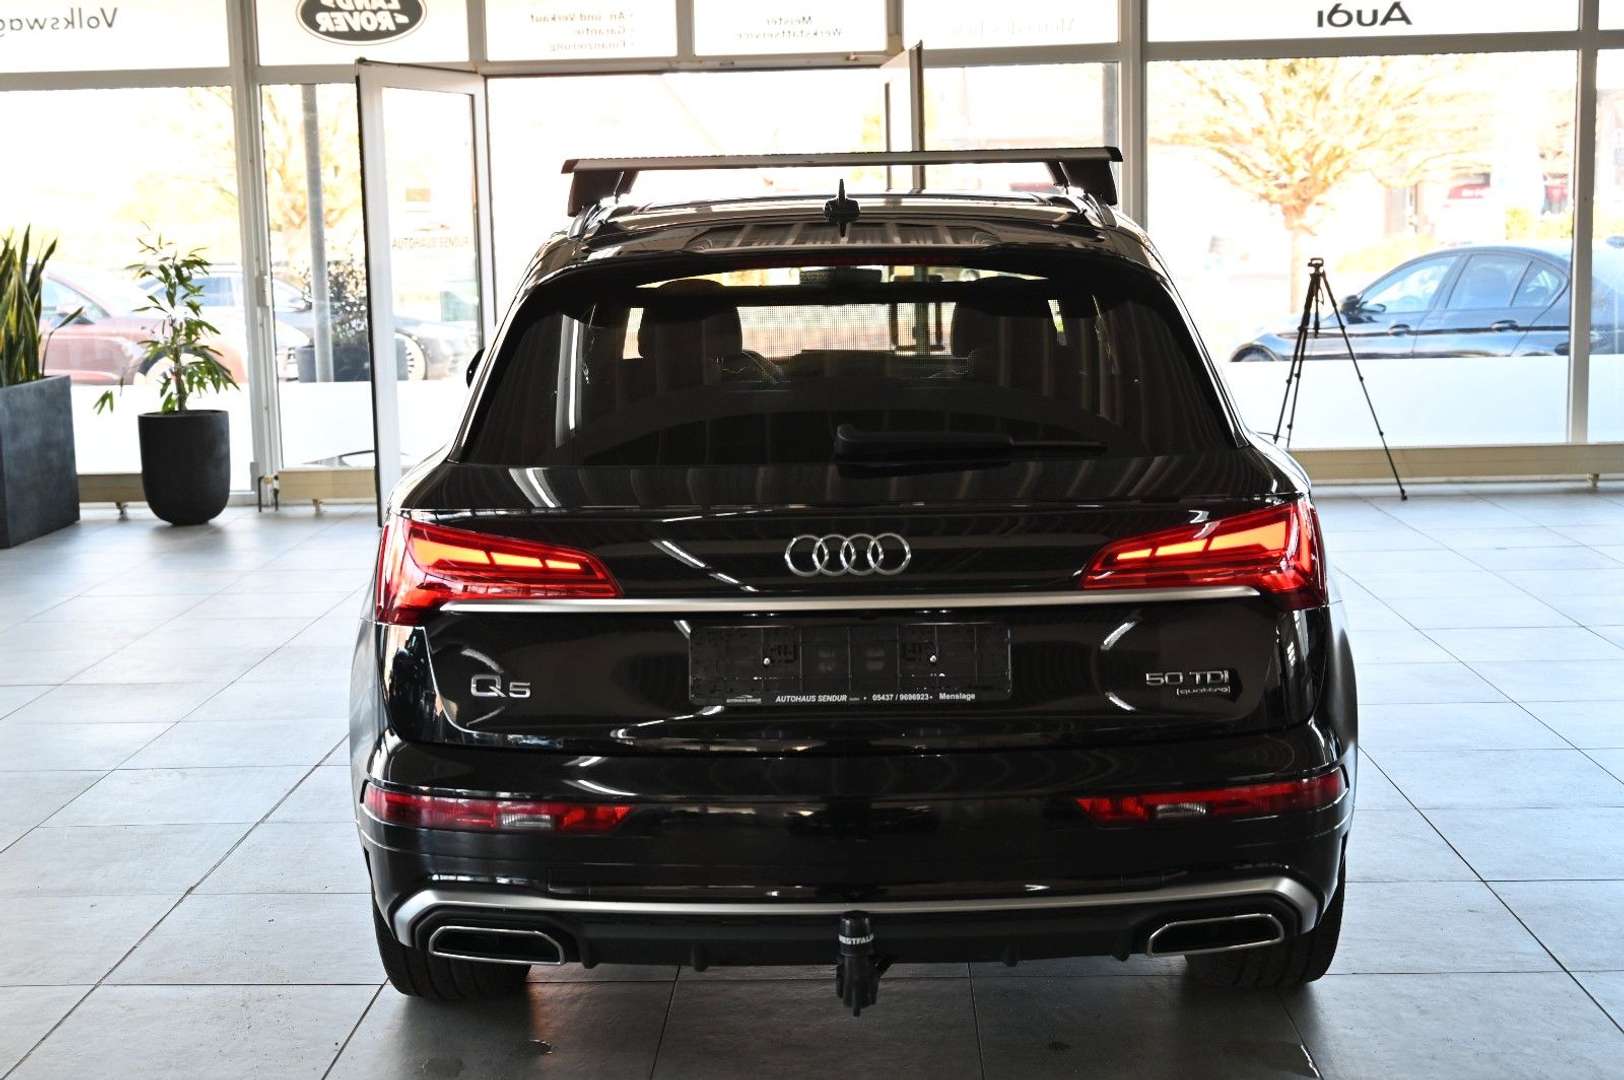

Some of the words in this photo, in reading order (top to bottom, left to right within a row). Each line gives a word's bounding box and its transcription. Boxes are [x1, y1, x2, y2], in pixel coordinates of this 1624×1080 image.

[470, 674, 530, 698] Q5
[1145, 672, 1183, 686] 50
[1189, 670, 1229, 685] TDI
[775, 695, 816, 703] AUTOHAUS
[817, 694, 847, 703] SENDUR
